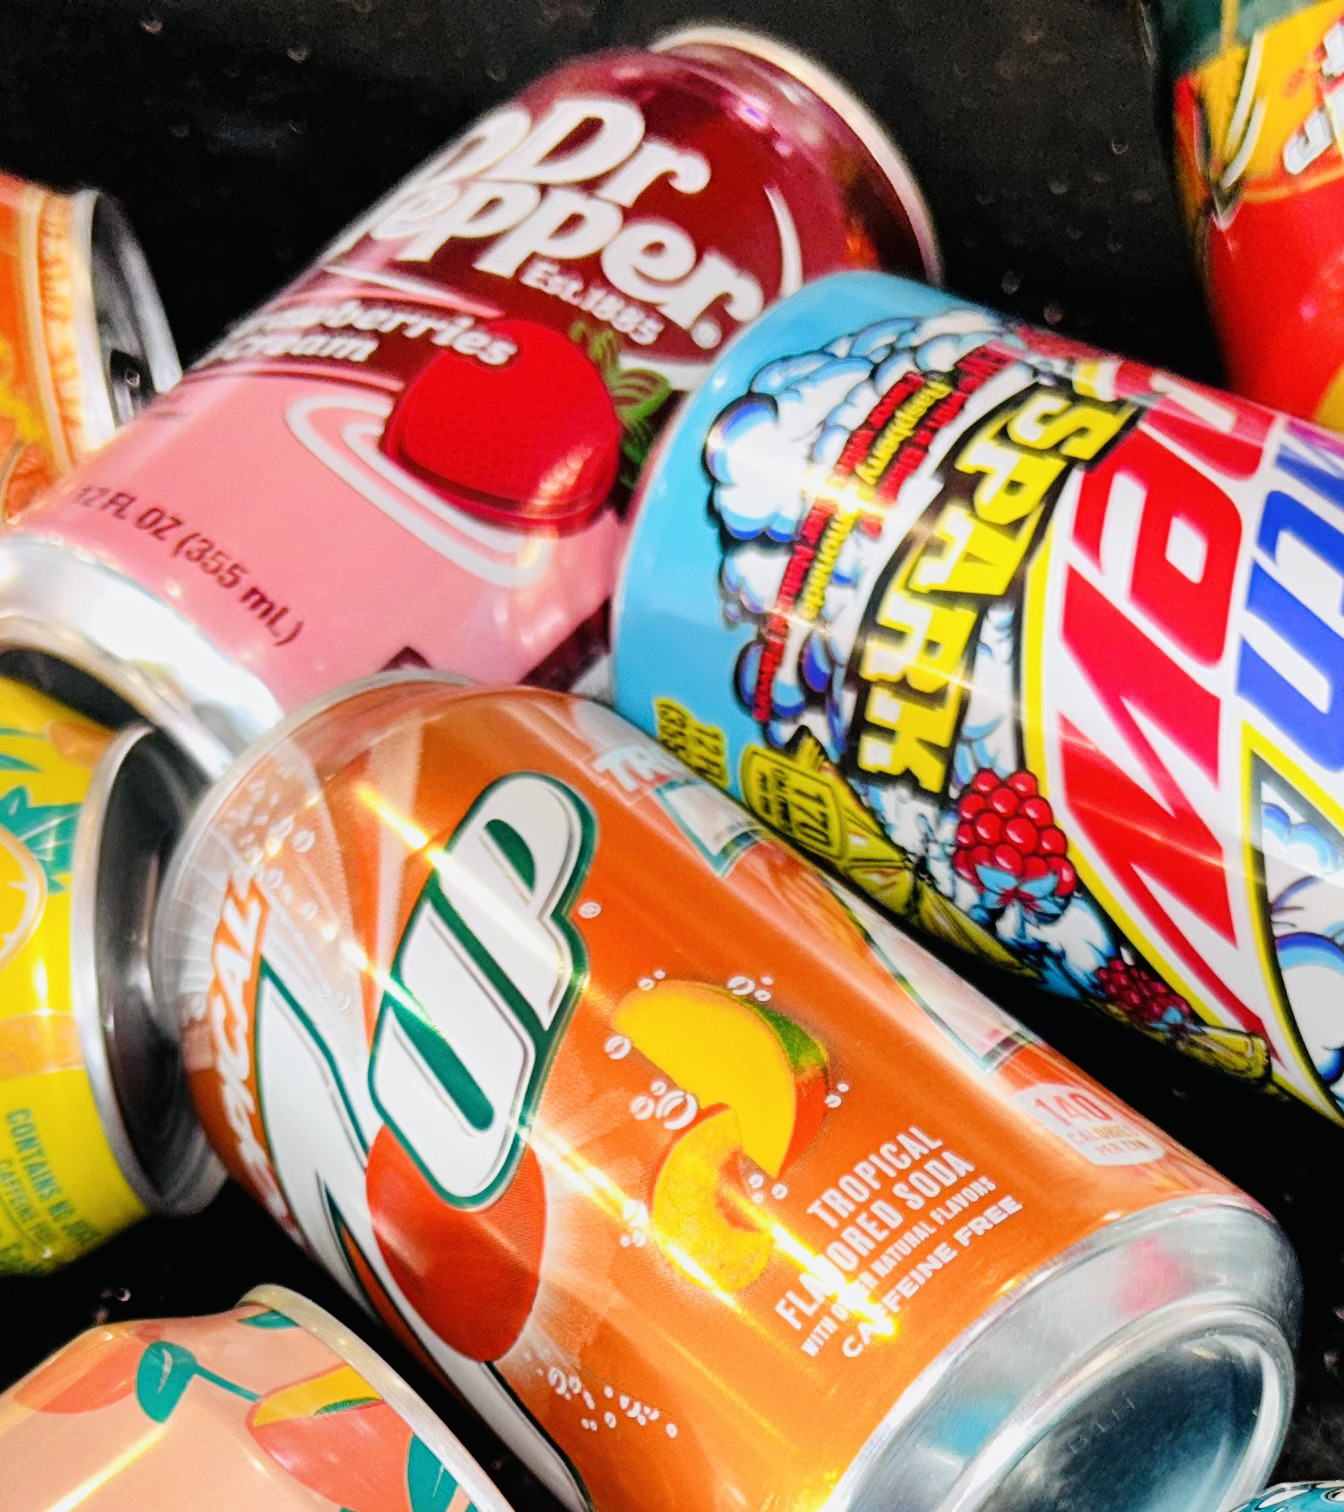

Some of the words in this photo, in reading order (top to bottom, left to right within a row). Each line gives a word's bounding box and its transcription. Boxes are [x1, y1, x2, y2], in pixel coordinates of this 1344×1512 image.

[494, 97, 711, 208] Dr
[100, 491, 134, 521] FL
[137, 507, 186, 543] OZ
[173, 531, 252, 591] (355
[239, 585, 306, 647] mL)
[859, 390, 1140, 793] SPARK
[794, 788, 834, 848] 170
[7, 1108, 63, 1202] CONTAINS
[1034, 1092, 1114, 1127] 140
[806, 1124, 944, 1229] TROPICAL
[892, 1150, 975, 1211] SODA
[952, 1195, 1024, 1248] FREE
[801, 1316, 838, 1357] WITH
[869, 1219, 937, 1278] NATURAL
[928, 1175, 997, 1226] FLAVORS
